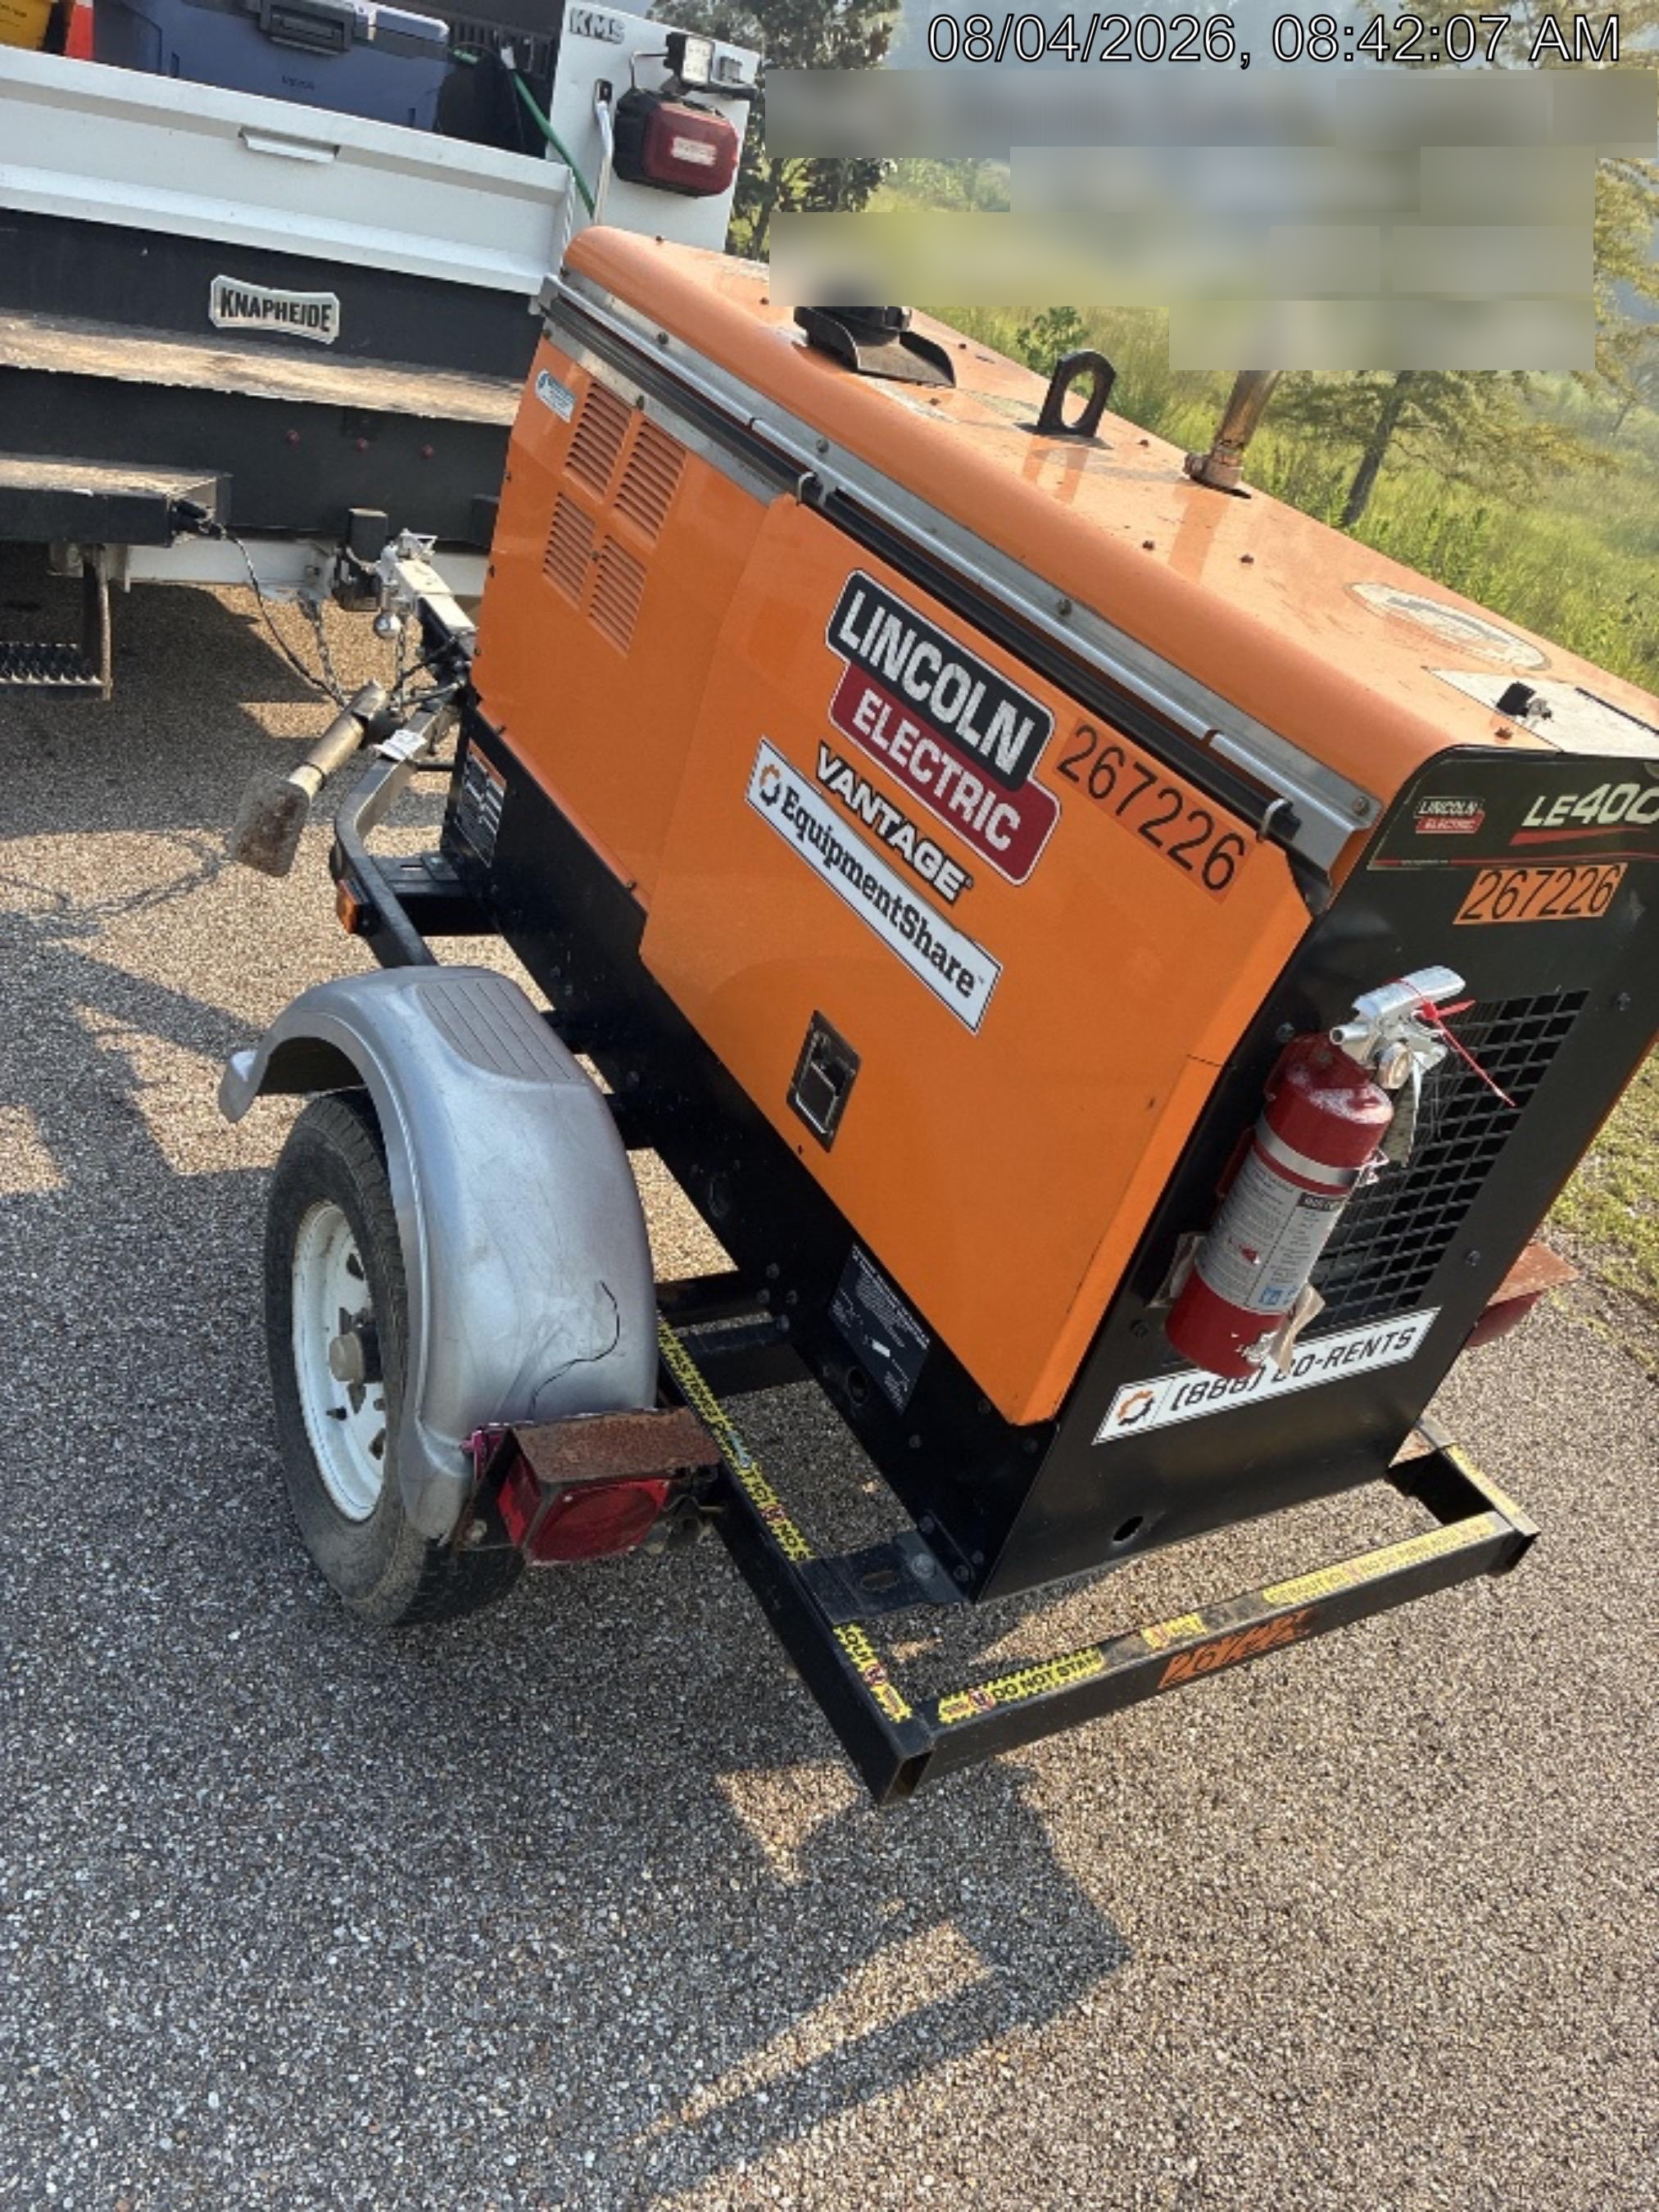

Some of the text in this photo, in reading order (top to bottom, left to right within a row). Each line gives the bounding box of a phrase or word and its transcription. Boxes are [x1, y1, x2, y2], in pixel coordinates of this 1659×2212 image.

[569, 7, 626, 44] KMS
[220, 287, 333, 333] KNAPHEIDE
[838, 589, 1035, 776] LINCOLN
[816, 741, 967, 904] VANTAGE
[852, 687, 1022, 853] ELECTRIC
[1056, 724, 1245, 891] 267226
[1417, 800, 1480, 817] LINCOLN
[781, 777, 976, 999] EquipmentShare
[1460, 864, 1621, 920] 267226
[991, 1682, 1018, 1699] DO
[1019, 1669, 1054, 1690] NOT
